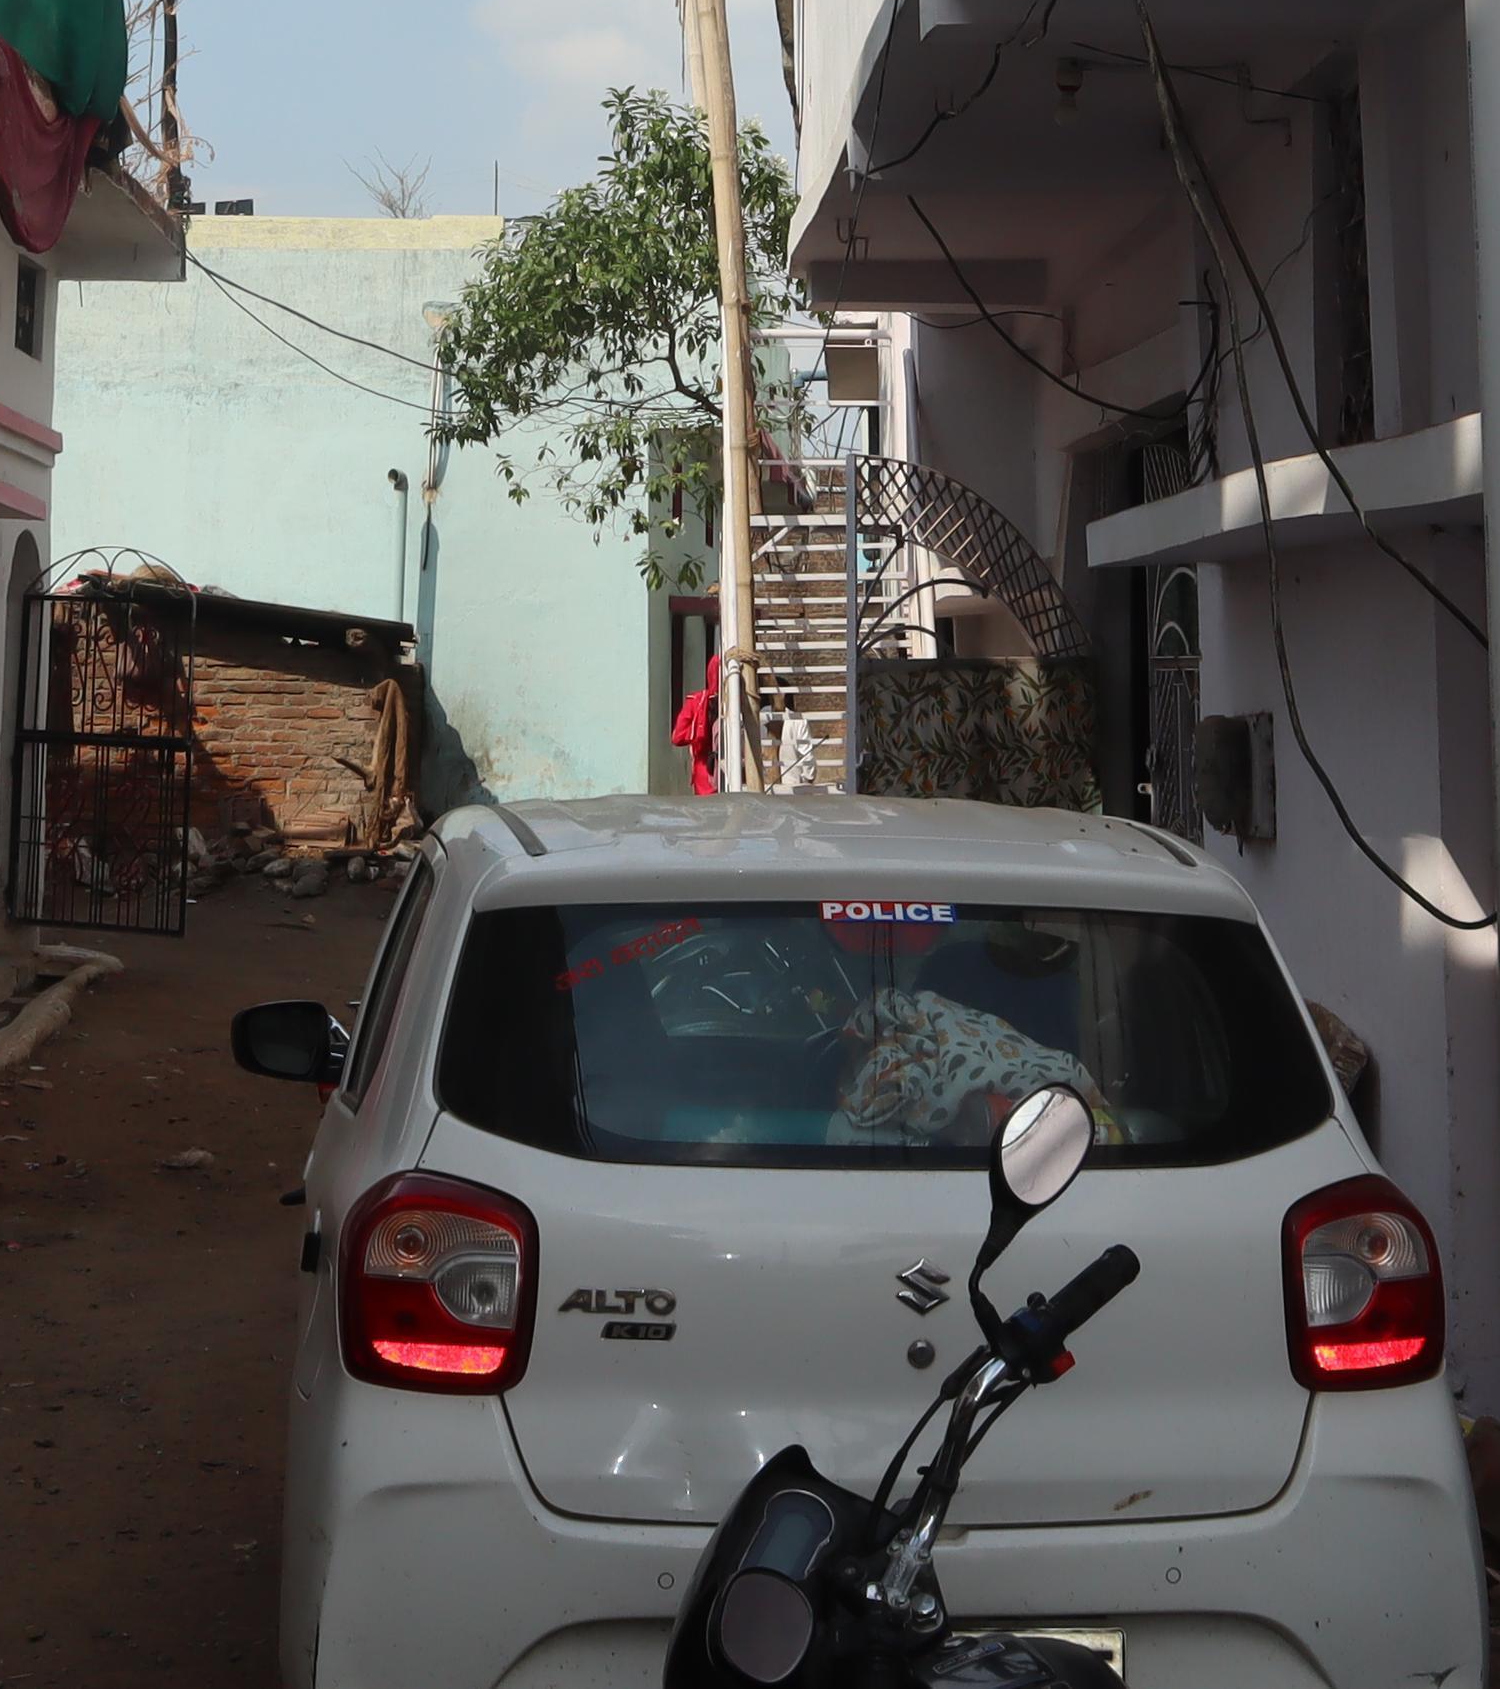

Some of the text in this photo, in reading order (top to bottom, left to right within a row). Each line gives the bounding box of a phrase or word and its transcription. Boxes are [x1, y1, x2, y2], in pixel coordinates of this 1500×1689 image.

[822, 902, 954, 923] POLICE
[557, 1288, 677, 1316] ALTO
[608, 1323, 669, 1340] K10
